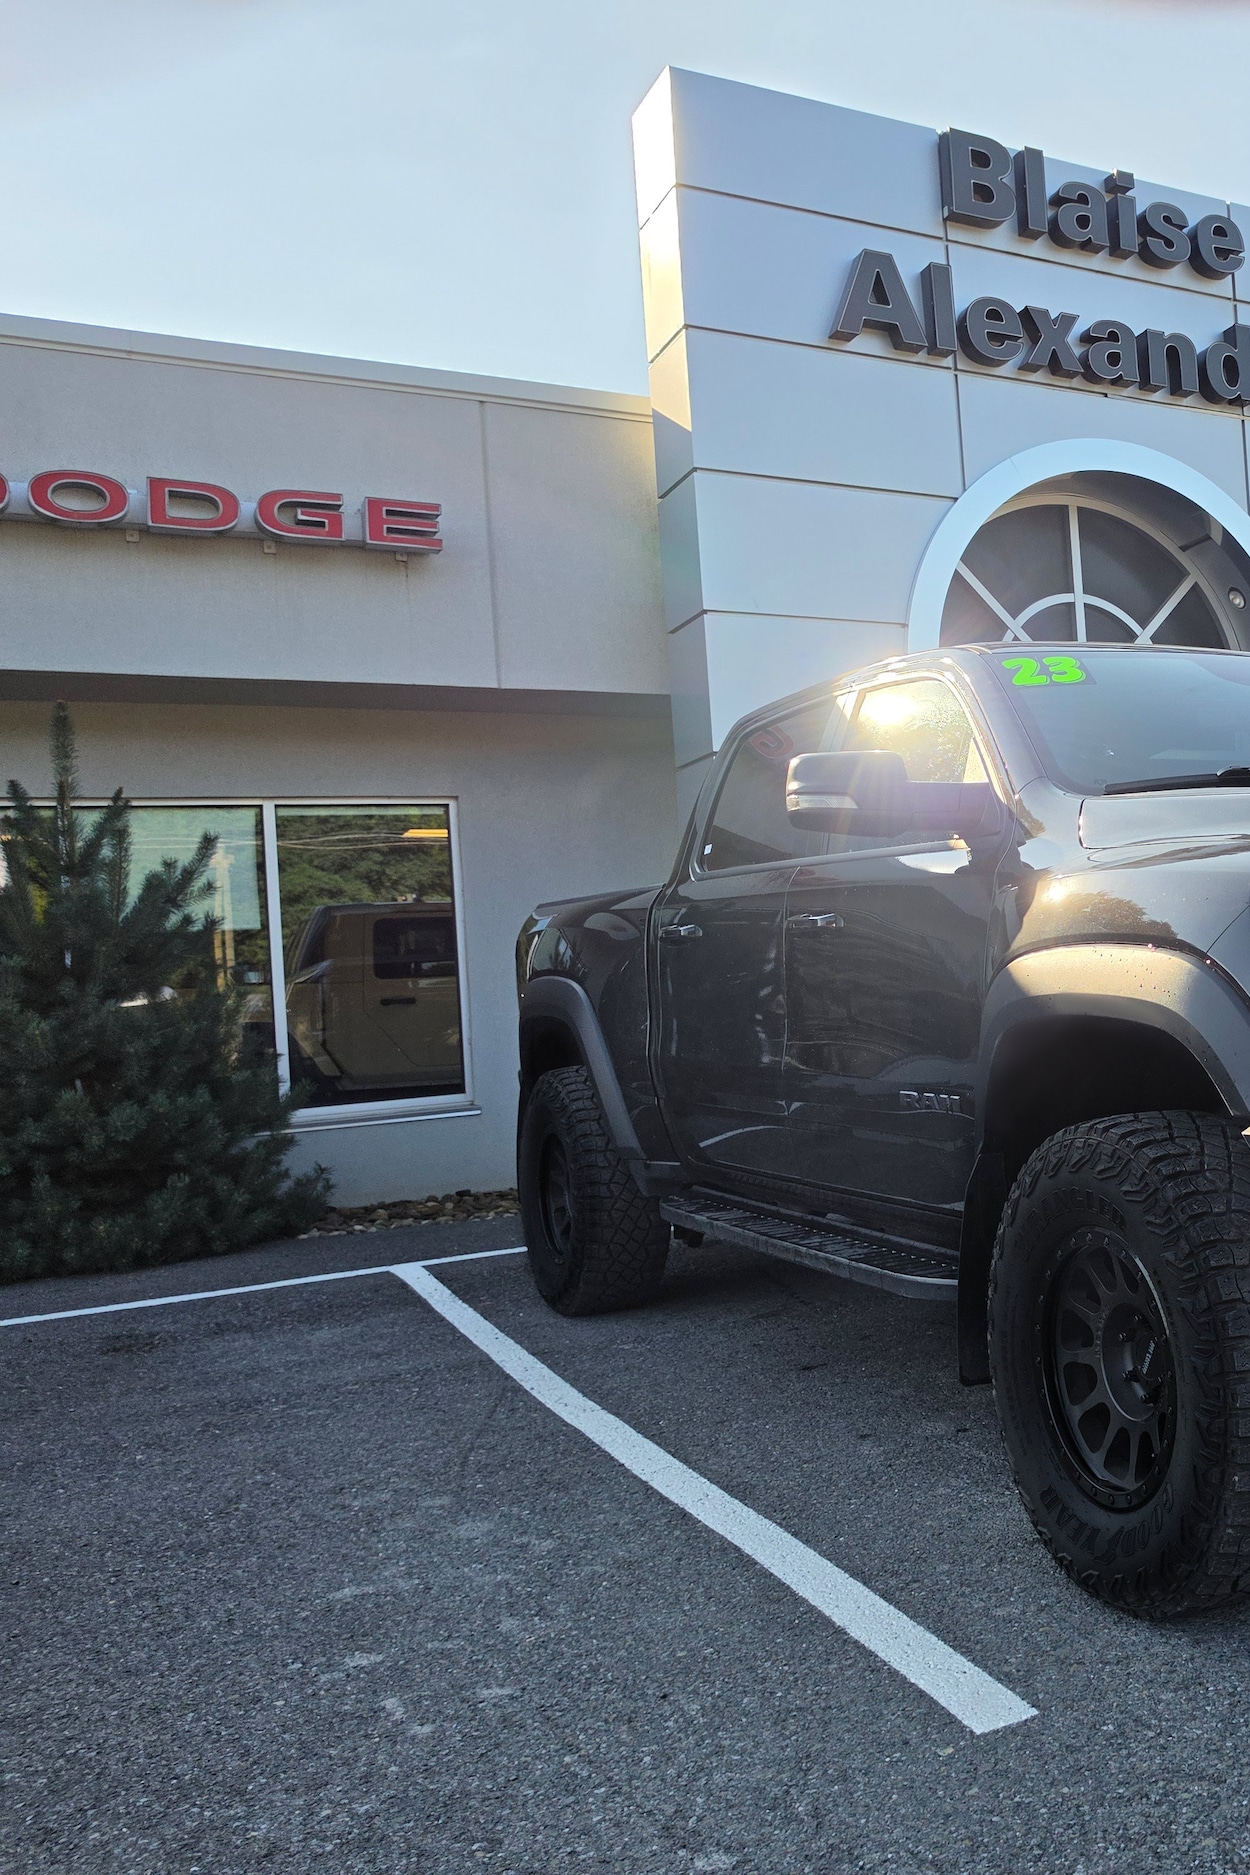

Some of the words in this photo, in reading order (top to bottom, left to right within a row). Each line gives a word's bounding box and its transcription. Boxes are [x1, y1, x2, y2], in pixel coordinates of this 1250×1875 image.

[937, 126, 1245, 281] Blaise
[0, 469, 444, 555] ODGE
[1001, 655, 1087, 687] 23
[1039, 1481, 1175, 1567] GOODYEAR
